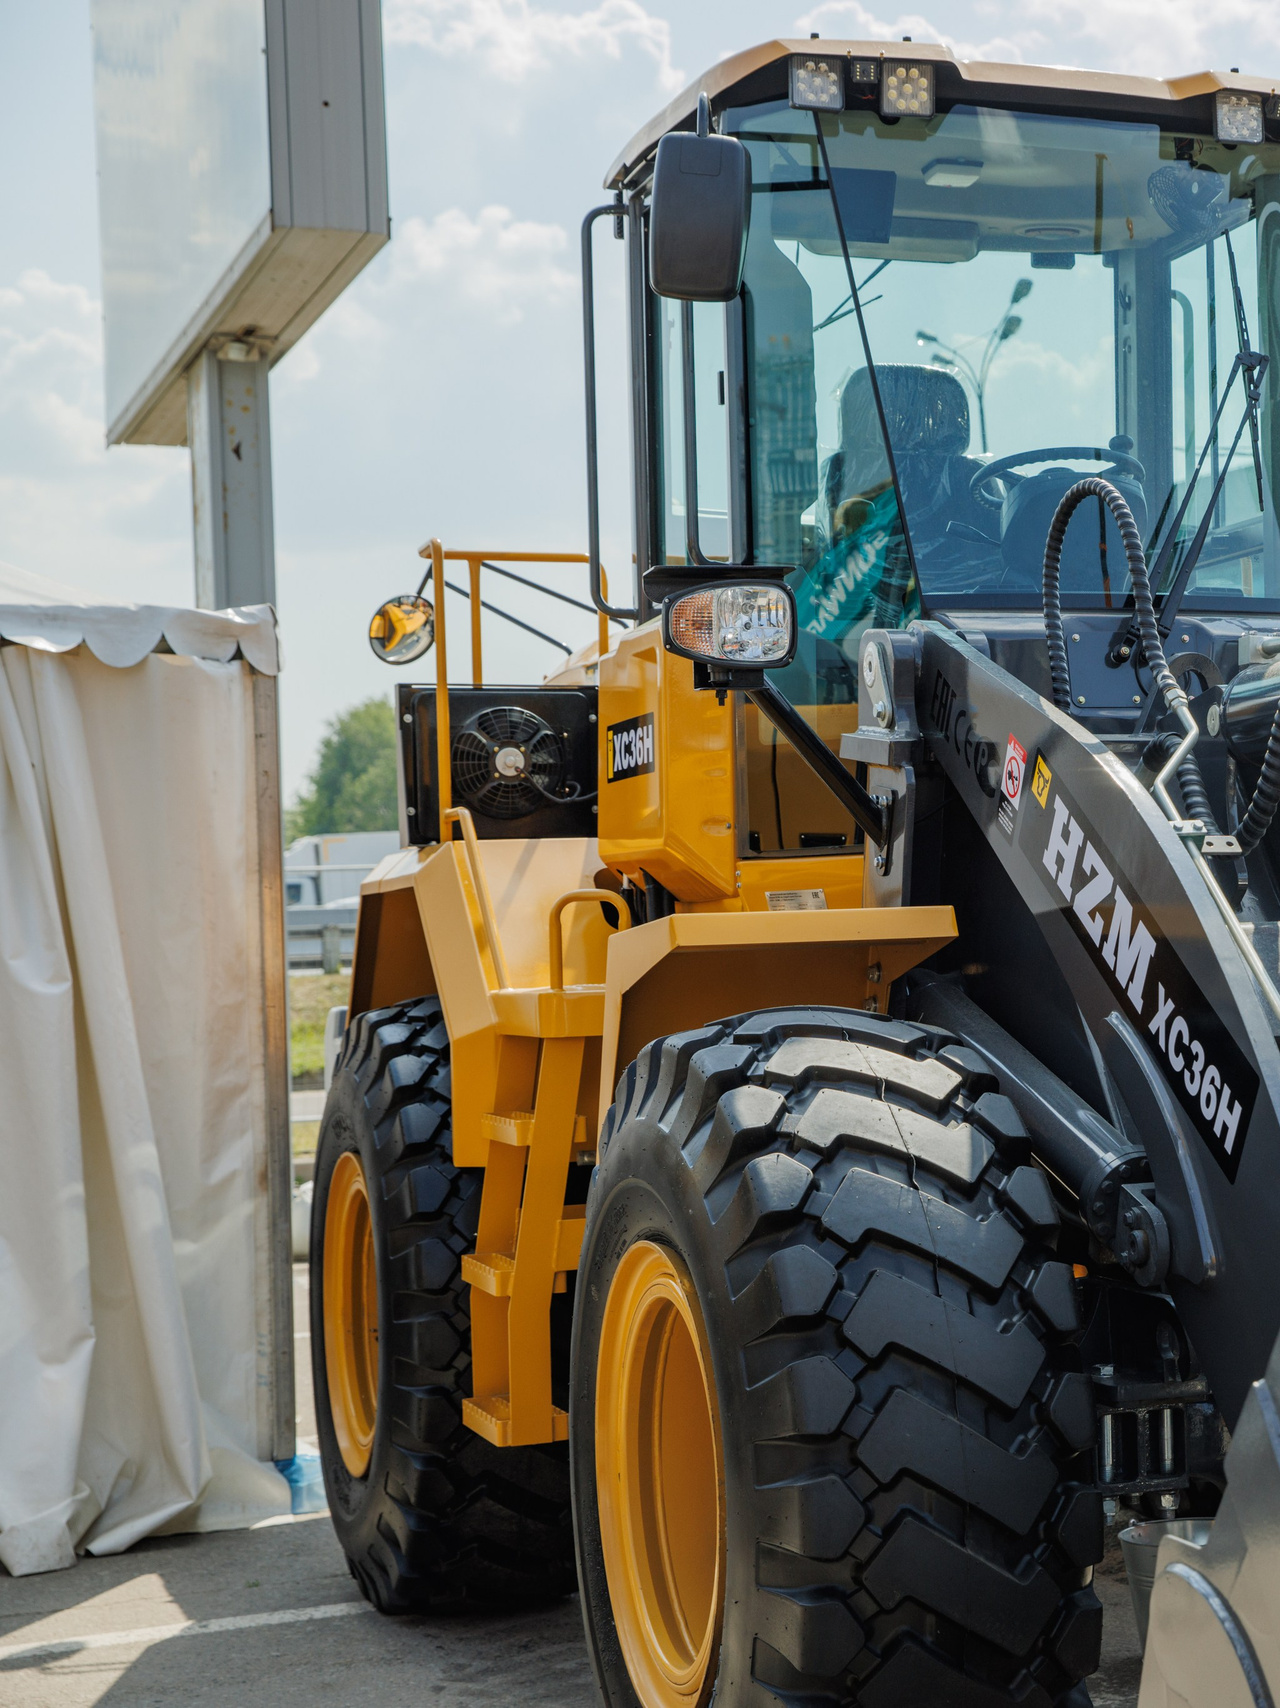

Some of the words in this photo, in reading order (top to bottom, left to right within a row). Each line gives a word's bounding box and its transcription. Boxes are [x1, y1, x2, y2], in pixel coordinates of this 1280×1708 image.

[613, 724, 653, 773] XC36H
[1041, 793, 1158, 1015] HZM
[1147, 981, 1243, 1156] XC36H
